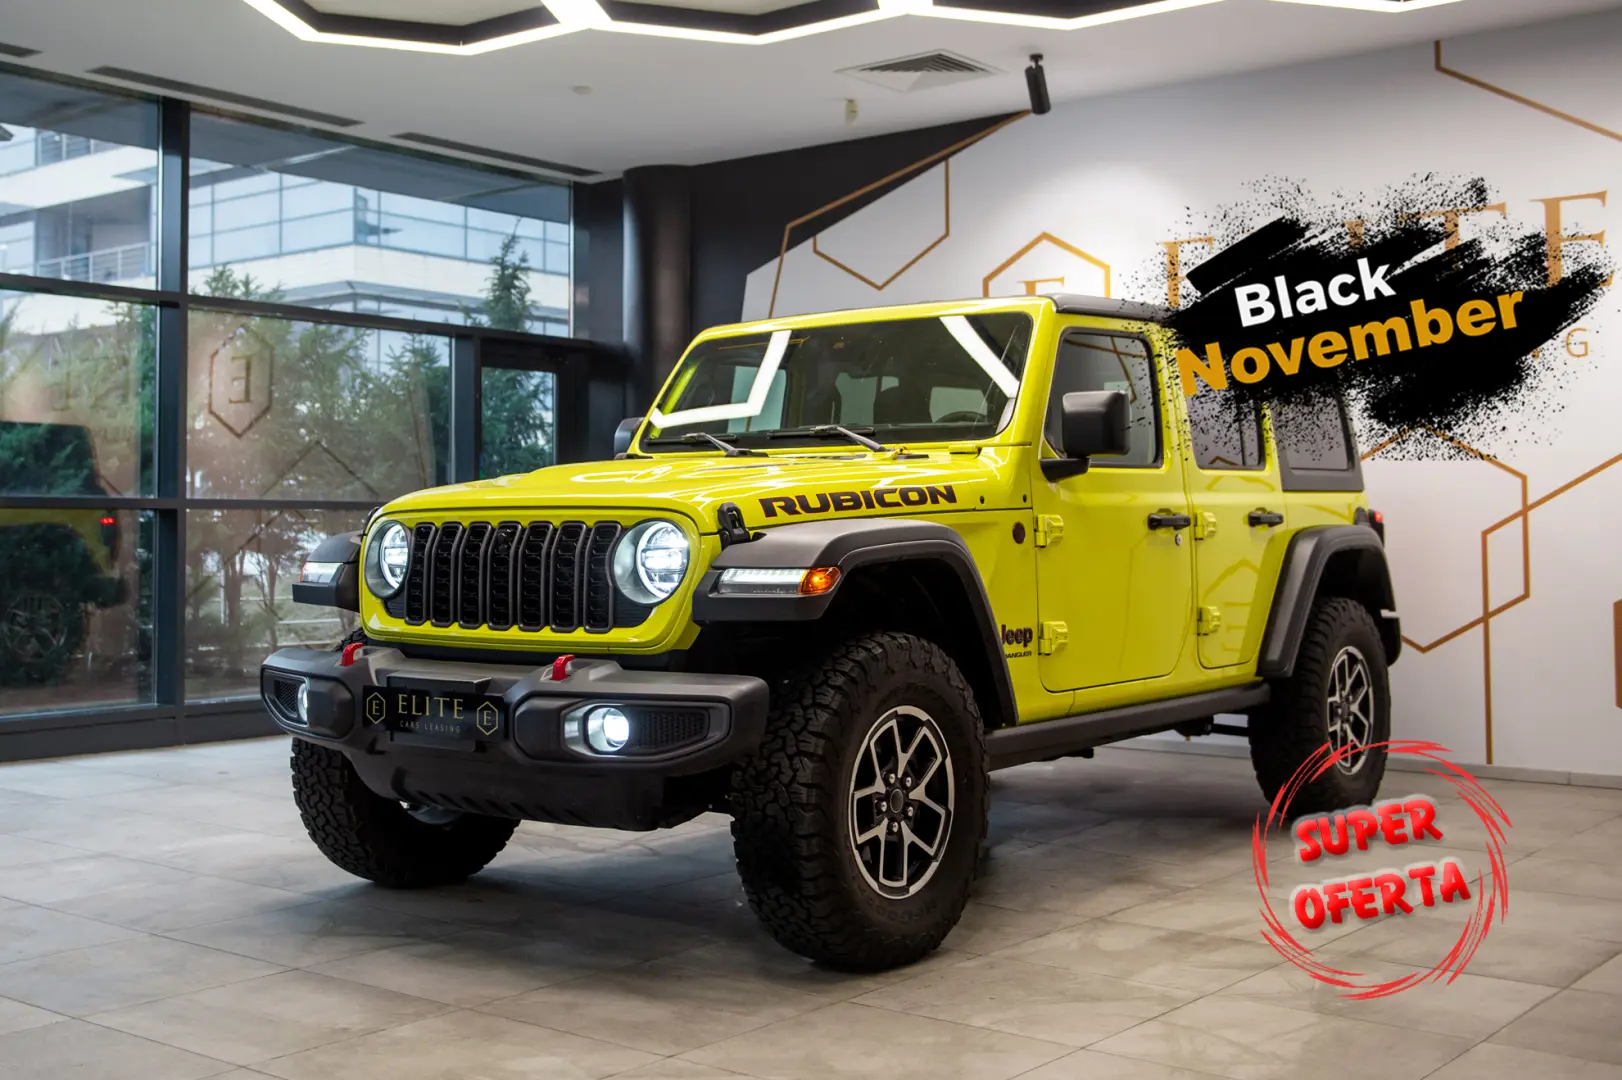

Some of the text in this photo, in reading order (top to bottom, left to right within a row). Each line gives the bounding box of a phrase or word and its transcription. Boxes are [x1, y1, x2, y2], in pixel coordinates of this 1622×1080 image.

[1159, 190, 1615, 309] ETE
[759, 485, 957, 517] RUBICON
[1001, 623, 1033, 648] Jeep
[1005, 650, 1033, 659] ANGLER
[372, 700, 380, 716] E
[397, 694, 464, 719] ELITE
[400, 720, 461, 734] CARS LEASING
[483, 710, 492, 726] E
